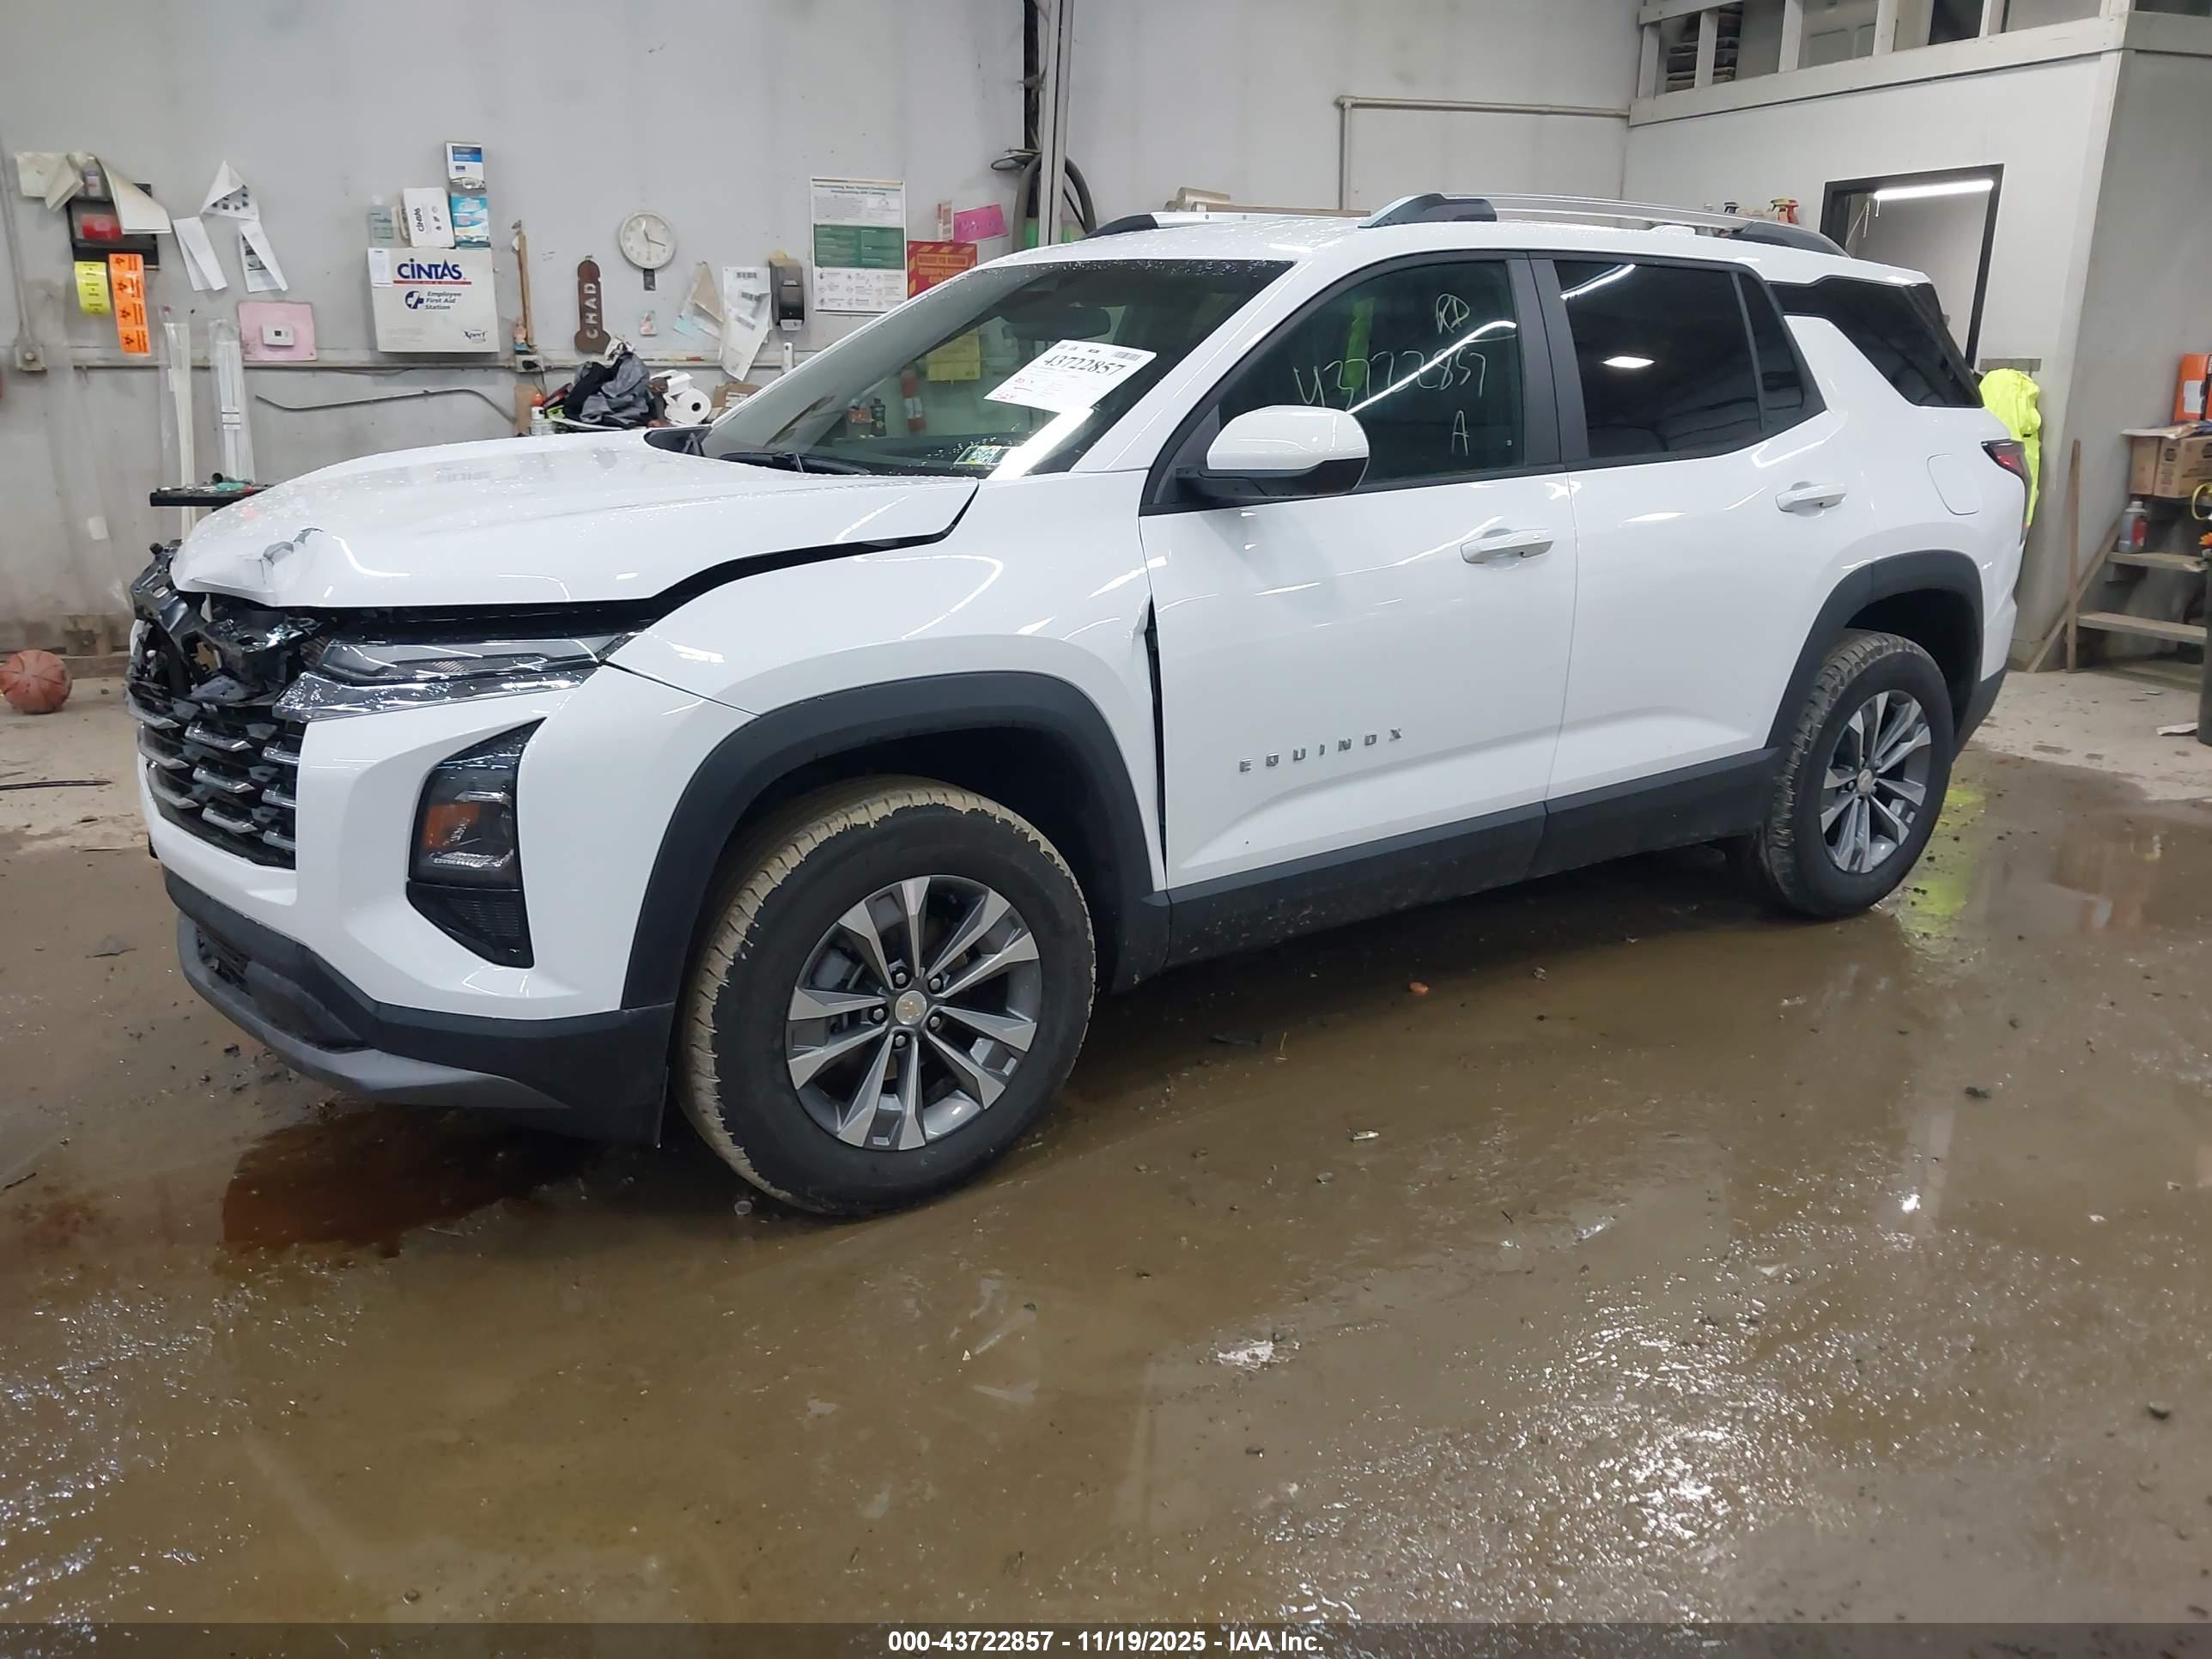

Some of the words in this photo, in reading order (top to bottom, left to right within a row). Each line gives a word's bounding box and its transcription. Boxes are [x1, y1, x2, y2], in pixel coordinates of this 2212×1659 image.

[427, 291, 462, 300] Employee
[583, 283, 599, 339] CHAD
[1043, 355, 1127, 376] 43722857
[1451, 410, 1470, 456] A
[1239, 728, 1402, 773] EQUINOX
